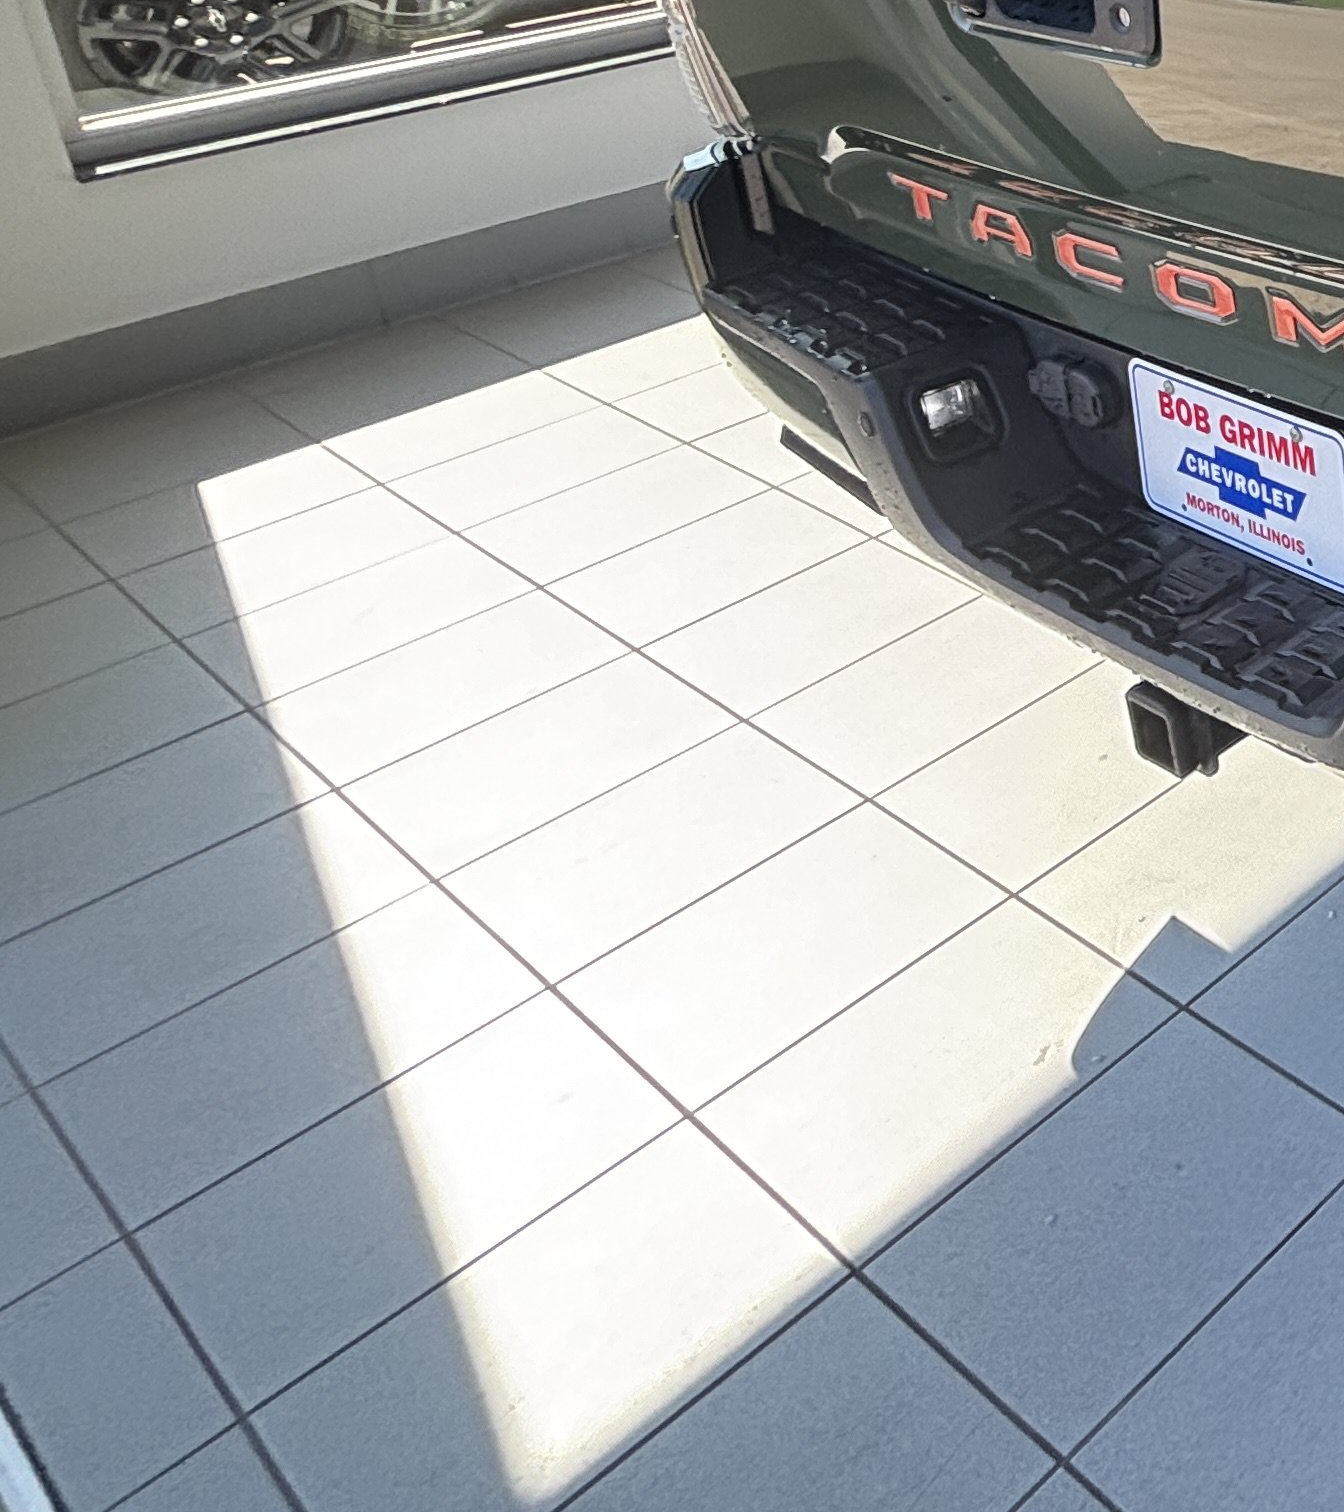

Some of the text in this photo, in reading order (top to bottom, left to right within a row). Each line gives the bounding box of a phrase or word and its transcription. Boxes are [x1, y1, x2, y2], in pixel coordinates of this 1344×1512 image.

[1157, 389, 1318, 478] BOB GRIMM
[1184, 452, 1296, 515] CHEVROLET
[1186, 491, 1307, 557] MORTON, ILLINOIS
